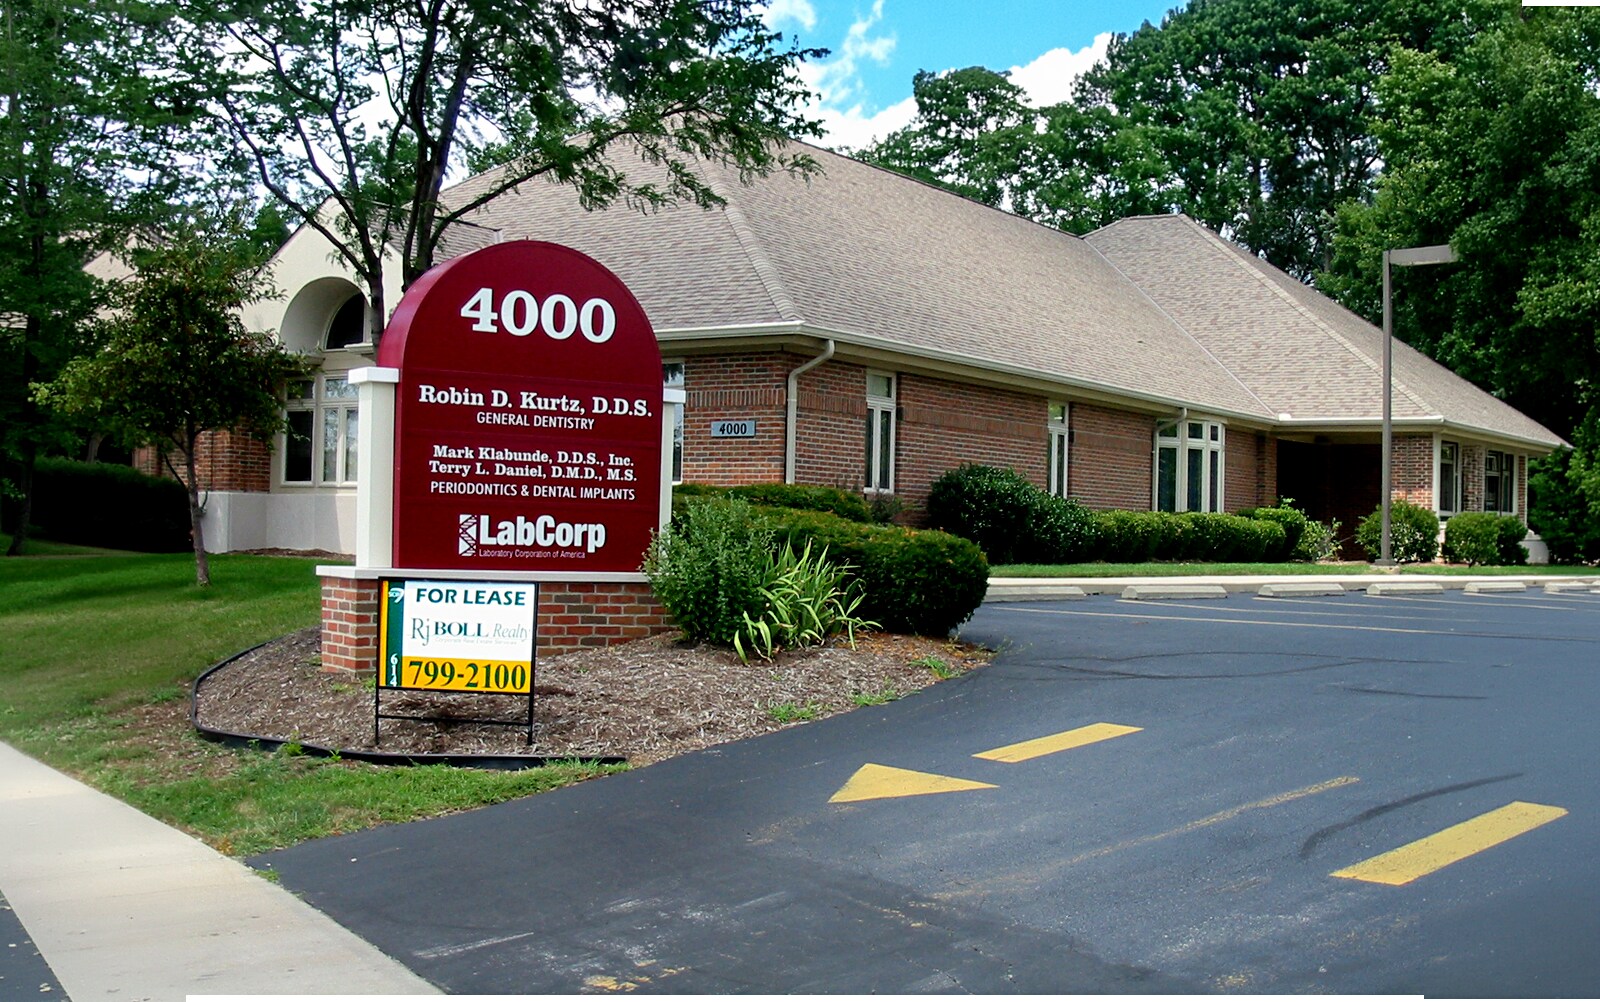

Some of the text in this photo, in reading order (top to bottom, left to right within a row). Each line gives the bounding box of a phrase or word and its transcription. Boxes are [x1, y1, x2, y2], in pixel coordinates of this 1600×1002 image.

[461, 288, 616, 343] 4000
[418, 384, 652, 417] Robin D. Kurtz, D.D.S.
[477, 411, 595, 430] GENERAL DENTISTRY
[719, 423, 747, 435] 4000
[433, 445, 634, 467] Mark Klabunde, D.D.S., Inc.
[429, 461, 637, 482] Terry L. Daniel, D.M.D., M.S.
[431, 481, 636, 501] PERIODONTICS & DENTAL IMPLANTS
[479, 514, 606, 553] LabCorp
[479, 549, 586, 559] Laboratory Corporation of America
[416, 588, 457, 604] FOR
[463, 589, 527, 606] LEASE
[411, 617, 430, 646] Rj
[434, 621, 490, 637] BOLL
[492, 623, 528, 642] Realty
[408, 660, 526, 691] 799-2100
